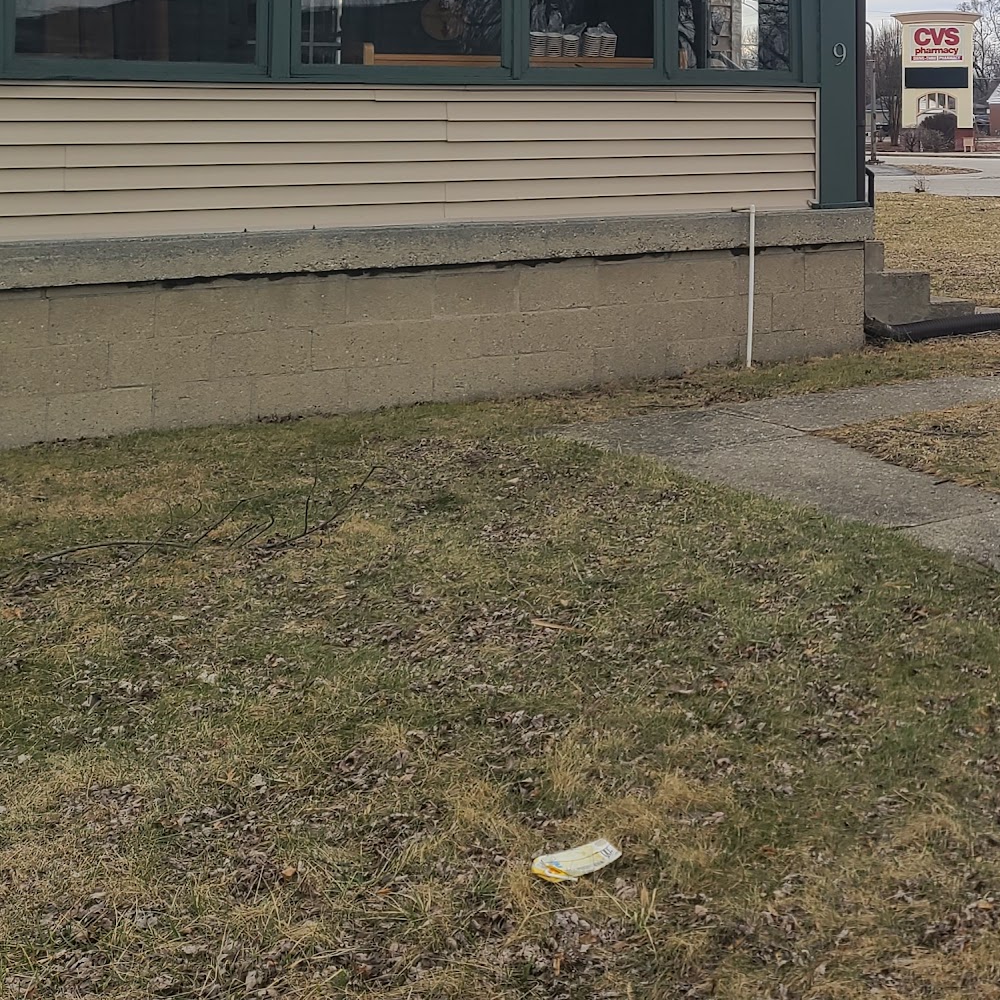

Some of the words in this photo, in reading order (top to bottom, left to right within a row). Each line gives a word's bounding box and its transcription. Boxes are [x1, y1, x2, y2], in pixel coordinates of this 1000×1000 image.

[914, 27, 960, 46] CVS
[833, 42, 846, 66] 9
[915, 47, 959, 56] pharmacy
